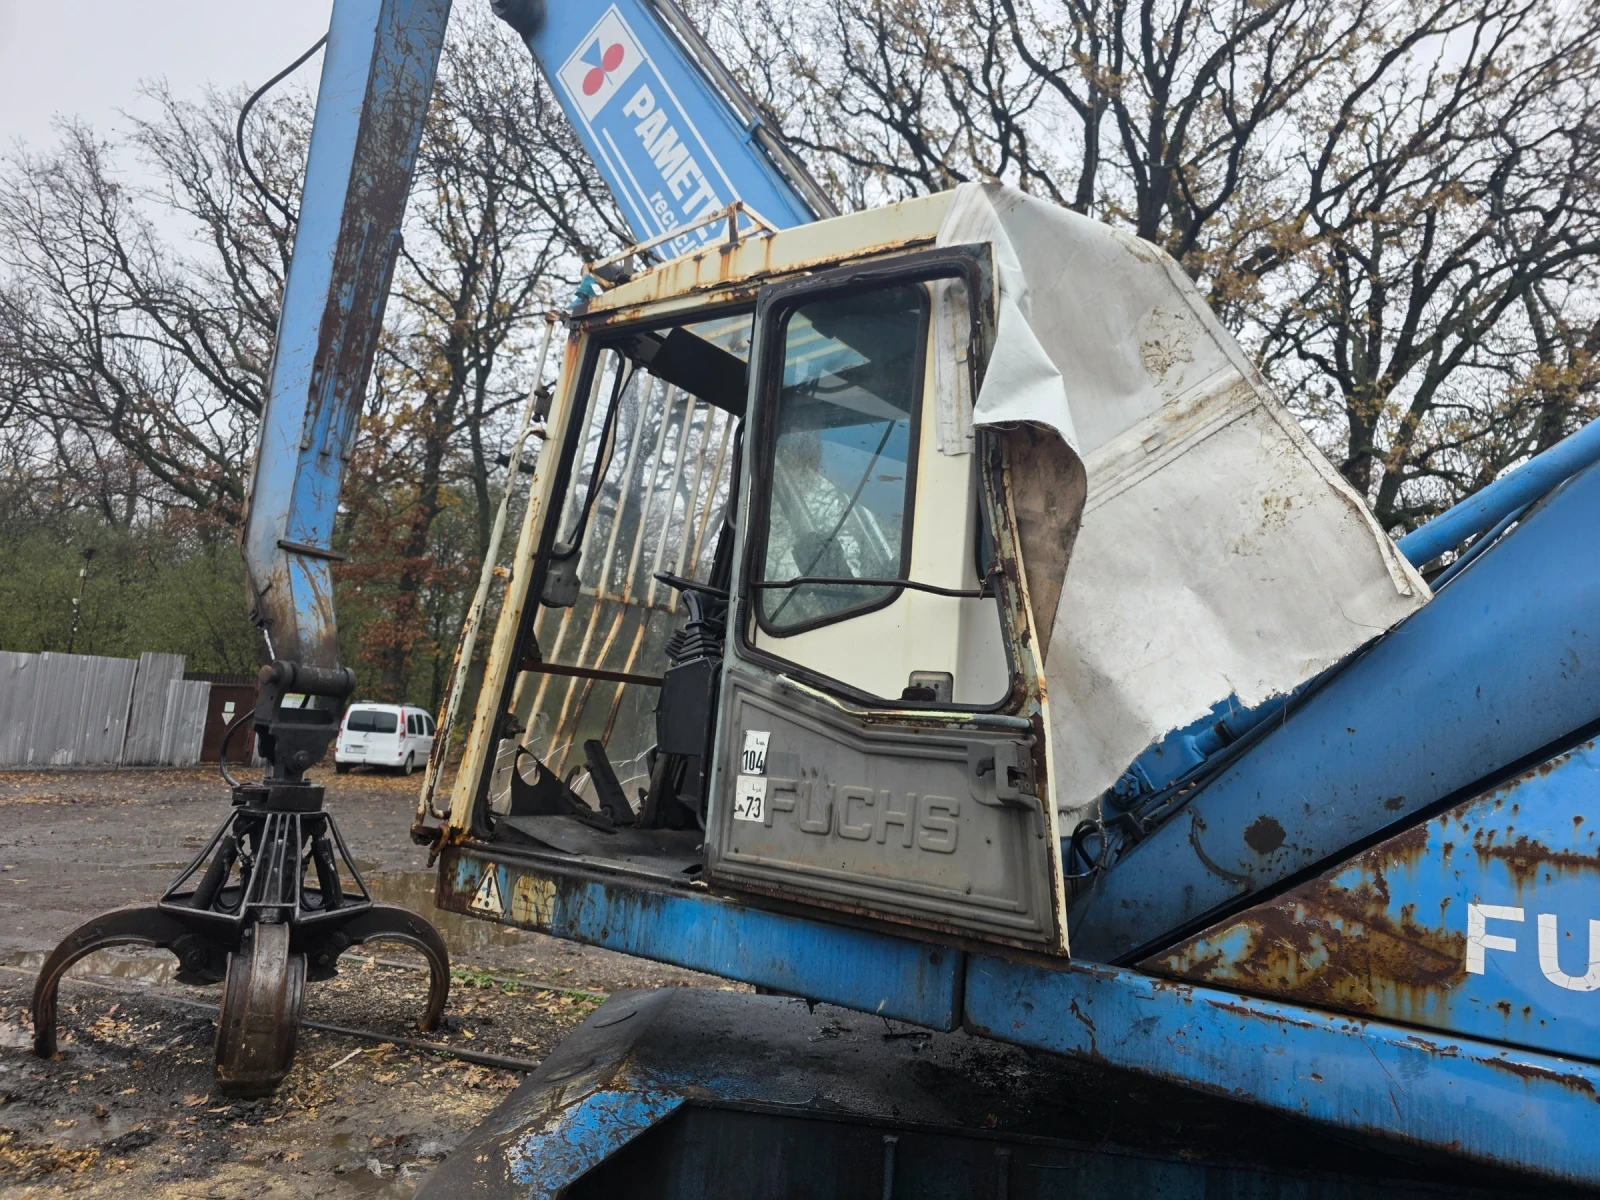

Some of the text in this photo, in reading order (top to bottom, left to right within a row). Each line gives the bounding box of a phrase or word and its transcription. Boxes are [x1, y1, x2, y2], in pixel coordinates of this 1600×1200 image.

[743, 750, 763, 771] 104
[745, 796, 761, 818] 73
[764, 778, 960, 854] FUCHS
[1466, 903, 1600, 992] FU
